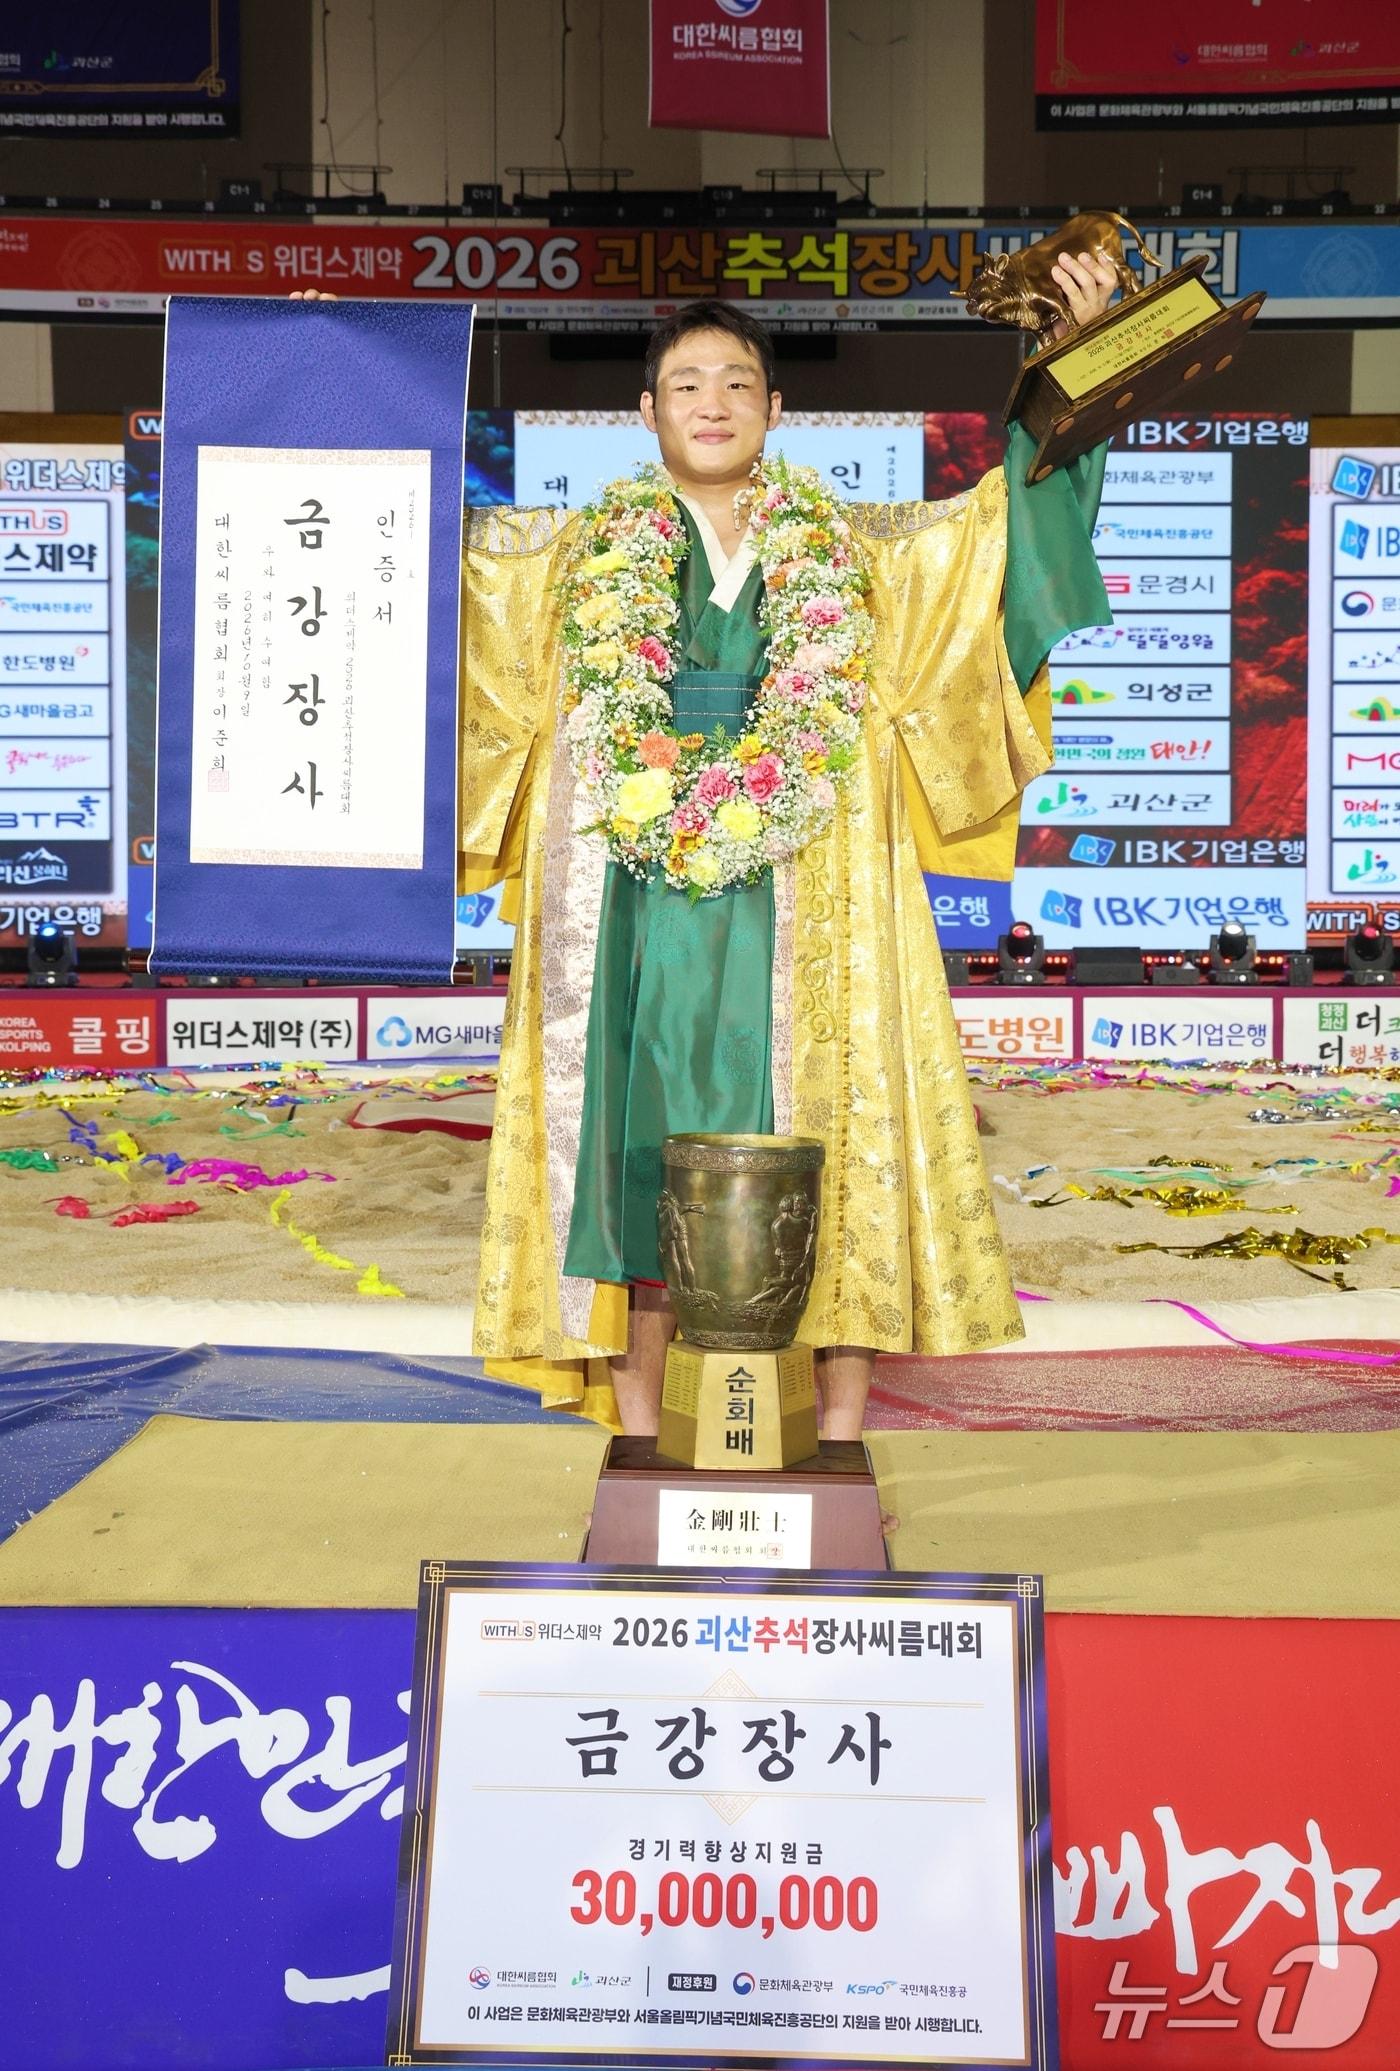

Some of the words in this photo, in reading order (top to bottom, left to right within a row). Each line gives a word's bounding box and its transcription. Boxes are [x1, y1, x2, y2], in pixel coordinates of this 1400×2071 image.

[673, 22, 803, 52] 대한씨름협회
[1318, 41, 1360, 54] 괴산군
[673, 52, 703, 60] KOREA
[705, 50, 743, 62] SSIREUM
[744, 53, 803, 65] ASSOCIATION
[229, 184, 250, 195] C1-1
[1192, 189, 1212, 200] C1-4
[273, 246, 403, 279] 위더스제약
[412, 235, 580, 290] 2026
[593, 231, 1239, 297] 괴산추석장사대회
[1115, 527, 1214, 541] 국민체육진흥공단
[373, 509, 396, 625] 인증서
[1137, 574, 1215, 595] 문경시
[1127, 634, 1214, 650] 달달영월
[3, 655, 75, 672] 한도병원
[281, 498, 331, 811] 금강장사
[1127, 683, 1213, 702] 의성군
[1149, 739, 1213, 761] 태안!
[1106, 793, 1214, 813] 괴산군
[1320, 1003, 1345, 1018] 청정
[1355, 1003, 1380, 1036] 더
[1320, 1017, 1345, 1032] 괴산
[0, 1029, 44, 1040] SPORTS
[172, 1020, 304, 1050] 위더스제약
[310, 1019, 352, 1050] (주)
[1318, 1035, 1343, 1066] 더
[725, 1366, 757, 1456] 순회배
[537, 1622, 603, 1642] 위더스제약
[612, 1616, 689, 1648] 2026
[695, 1615, 983, 1659] 괴산추석장사씨름대회
[565, 1706, 892, 1786] 금강장사
[628, 1838, 824, 1866] 경기력향상지원금
[569, 1868, 879, 1940] 30,000,000
[496, 1970, 558, 1983] 대한씨름협회
[595, 1974, 632, 1987] 괴산군
[671, 1975, 714, 1990] 재정후원
[759, 1978, 834, 1993] 문화체육관광부
[846, 1983, 886, 1996] KSPO
[467, 2006, 480, 2021] 이
[484, 2006, 523, 2022] 사업은
[526, 2007, 631, 2024] 문화체육관광부와
[633, 2008, 838, 2030] 서울올림픽기념국민체육진흥공단의
[842, 2014, 881, 2030] 지원을
[884, 2015, 912, 2031] 받아
[914, 2016, 984, 2034] 시행합니다.
